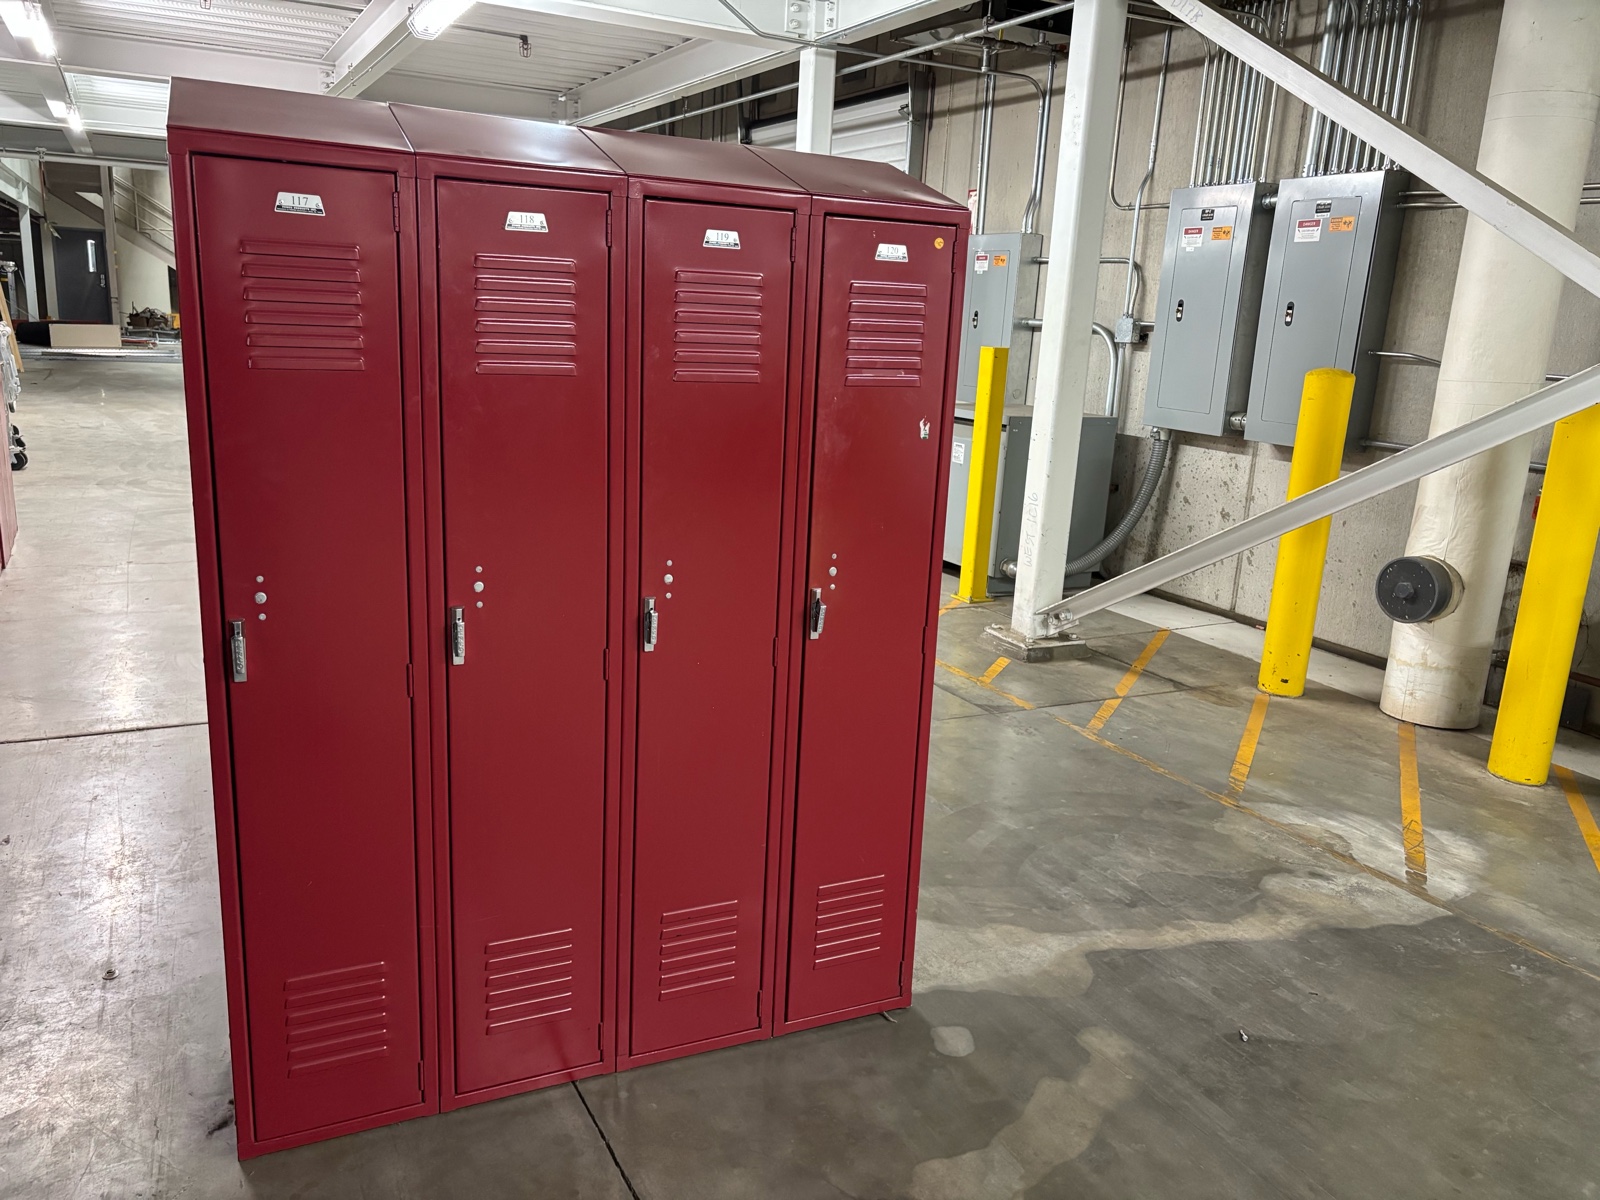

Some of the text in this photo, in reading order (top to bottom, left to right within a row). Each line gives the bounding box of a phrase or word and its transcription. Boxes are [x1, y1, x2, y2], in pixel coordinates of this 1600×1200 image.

[291, 195, 309, 206] 117
[520, 214, 535, 224] 118
[716, 232, 730, 241] 119
[886, 246, 899, 255] 120
[1023, 532, 1036, 568] WEST
